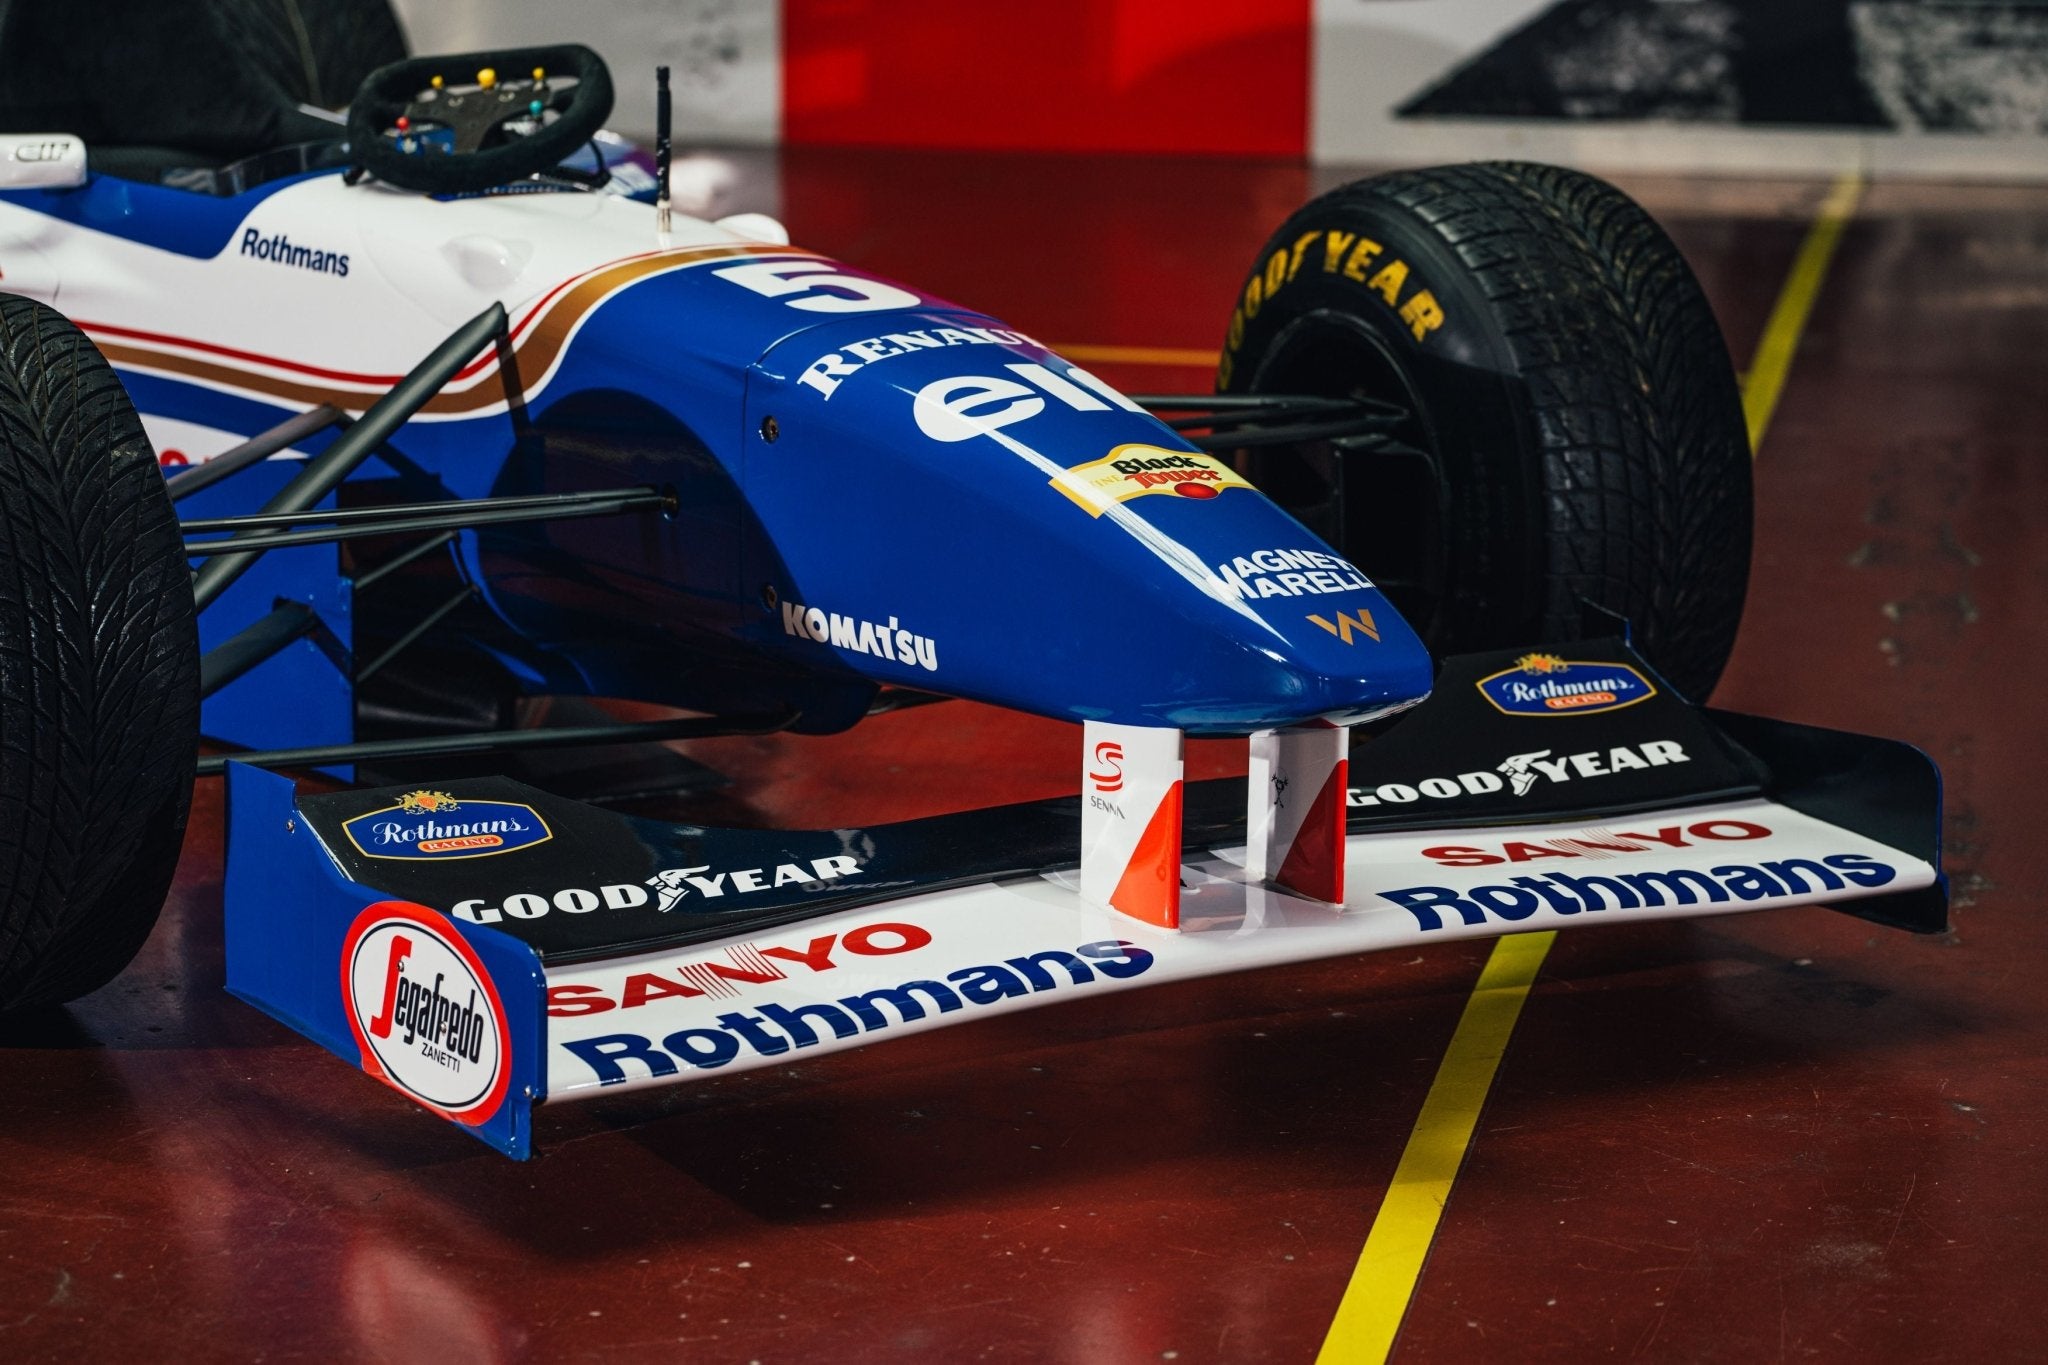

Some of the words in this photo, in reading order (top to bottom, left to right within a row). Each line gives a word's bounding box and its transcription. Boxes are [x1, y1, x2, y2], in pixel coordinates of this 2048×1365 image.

[241, 228, 349, 277] Rothmans
[711, 261, 921, 313] 5
[1110, 455, 1210, 475] Black
[1124, 469, 1222, 489] Tower
[1207, 549, 1360, 592] MAGNET
[782, 601, 938, 672] KOMATSU
[1502, 677, 1635, 702] Rothmans
[1090, 795, 1125, 820] SENNA
[372, 817, 529, 845] Rothmans
[428, 837, 495, 850] RACING
[1421, 820, 1772, 867] SANYO
[1378, 854, 1896, 931] Rothmans
[547, 922, 932, 1017] SANYO
[369, 935, 485, 1065] Segafredo
[560, 940, 1154, 1087] Rothmans
[421, 1042, 461, 1074] ZANETTI
